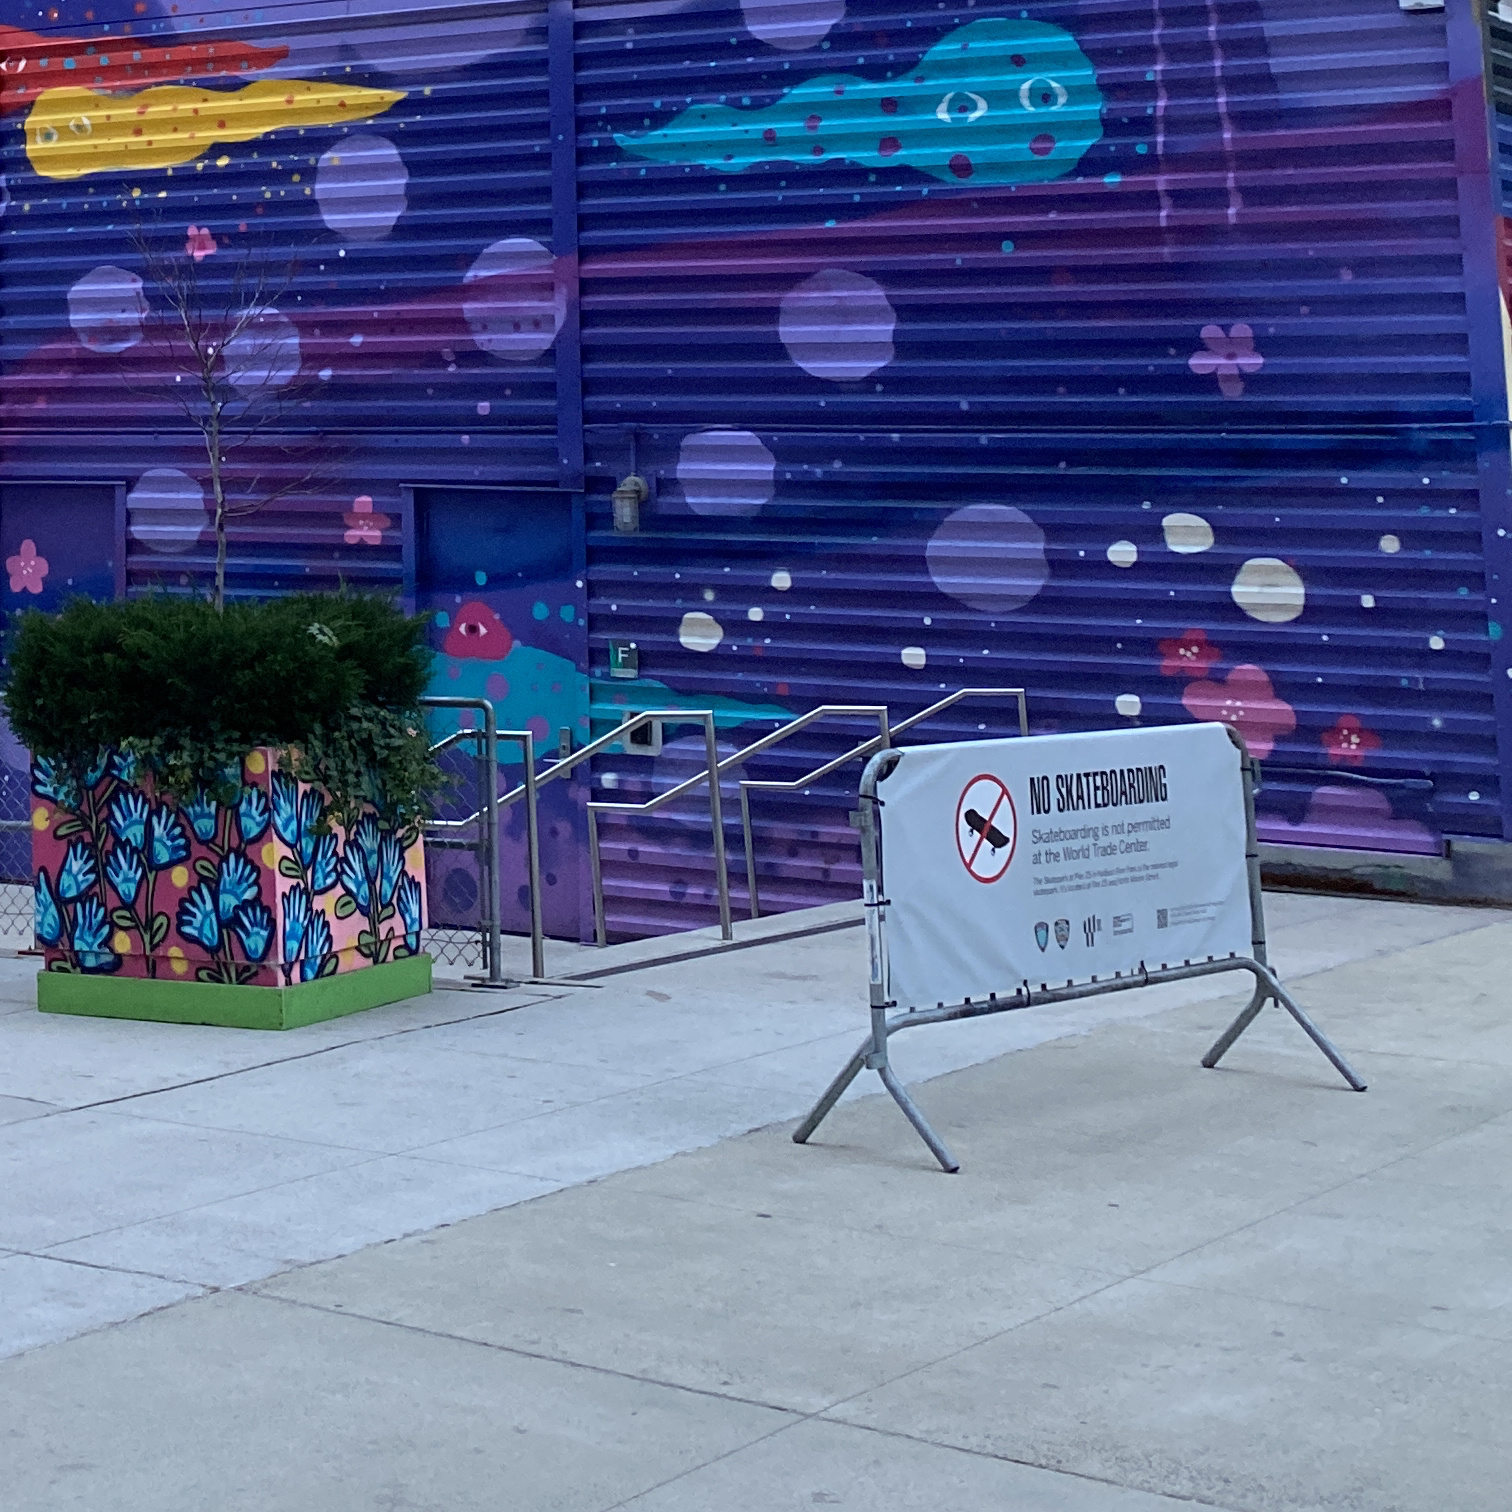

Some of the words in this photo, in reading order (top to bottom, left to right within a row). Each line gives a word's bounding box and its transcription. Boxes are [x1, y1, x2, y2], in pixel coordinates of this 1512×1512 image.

[618, 647, 630, 664] F
[1029, 775, 1051, 815] NO
[1055, 764, 1168, 813] SKATEBOARDING
[1031, 824, 1099, 845] Skateboarding
[1101, 823, 1110, 837] is
[1111, 821, 1126, 836] not
[1126, 815, 1171, 838] permitted
[1031, 850, 1042, 865] at
[1044, 848, 1061, 863] the
[1062, 844, 1090, 861] World
[1092, 842, 1118, 858] Trade
